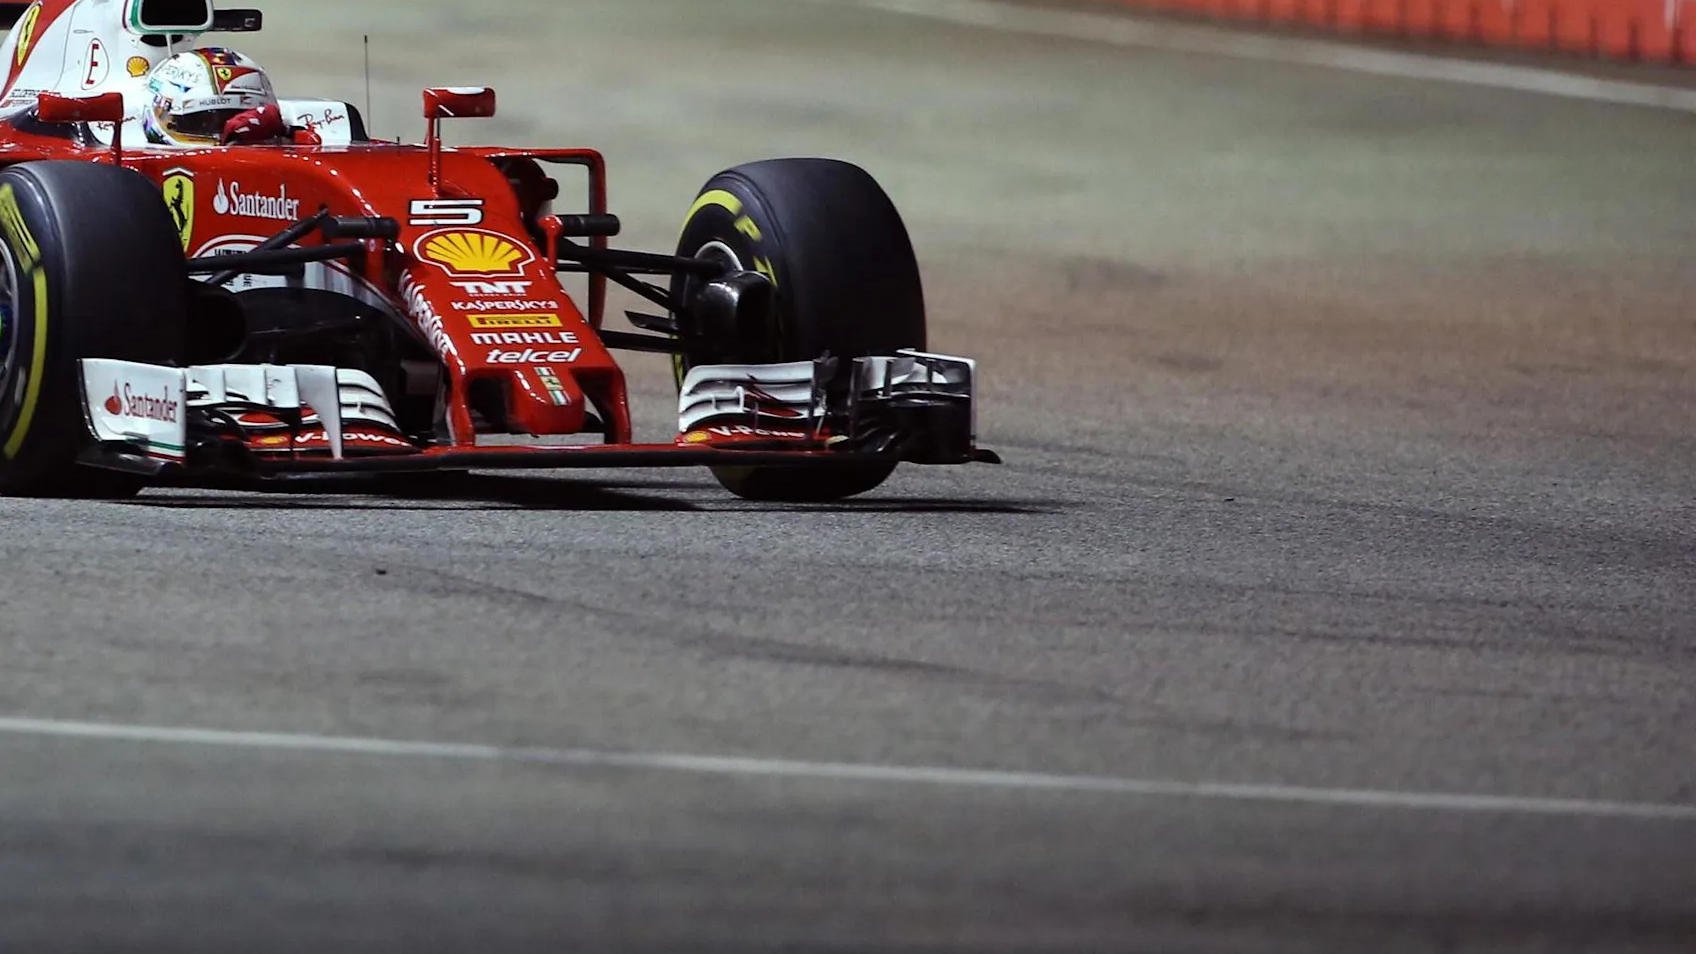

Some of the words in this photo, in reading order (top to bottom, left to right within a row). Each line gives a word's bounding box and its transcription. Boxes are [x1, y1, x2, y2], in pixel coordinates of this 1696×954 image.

[230, 181, 299, 221] Santander
[409, 199, 483, 225] 5
[449, 281, 533, 293] TNT
[470, 331, 579, 344] MAHLE
[485, 348, 582, 363] telcel
[124, 382, 177, 423] Santander
